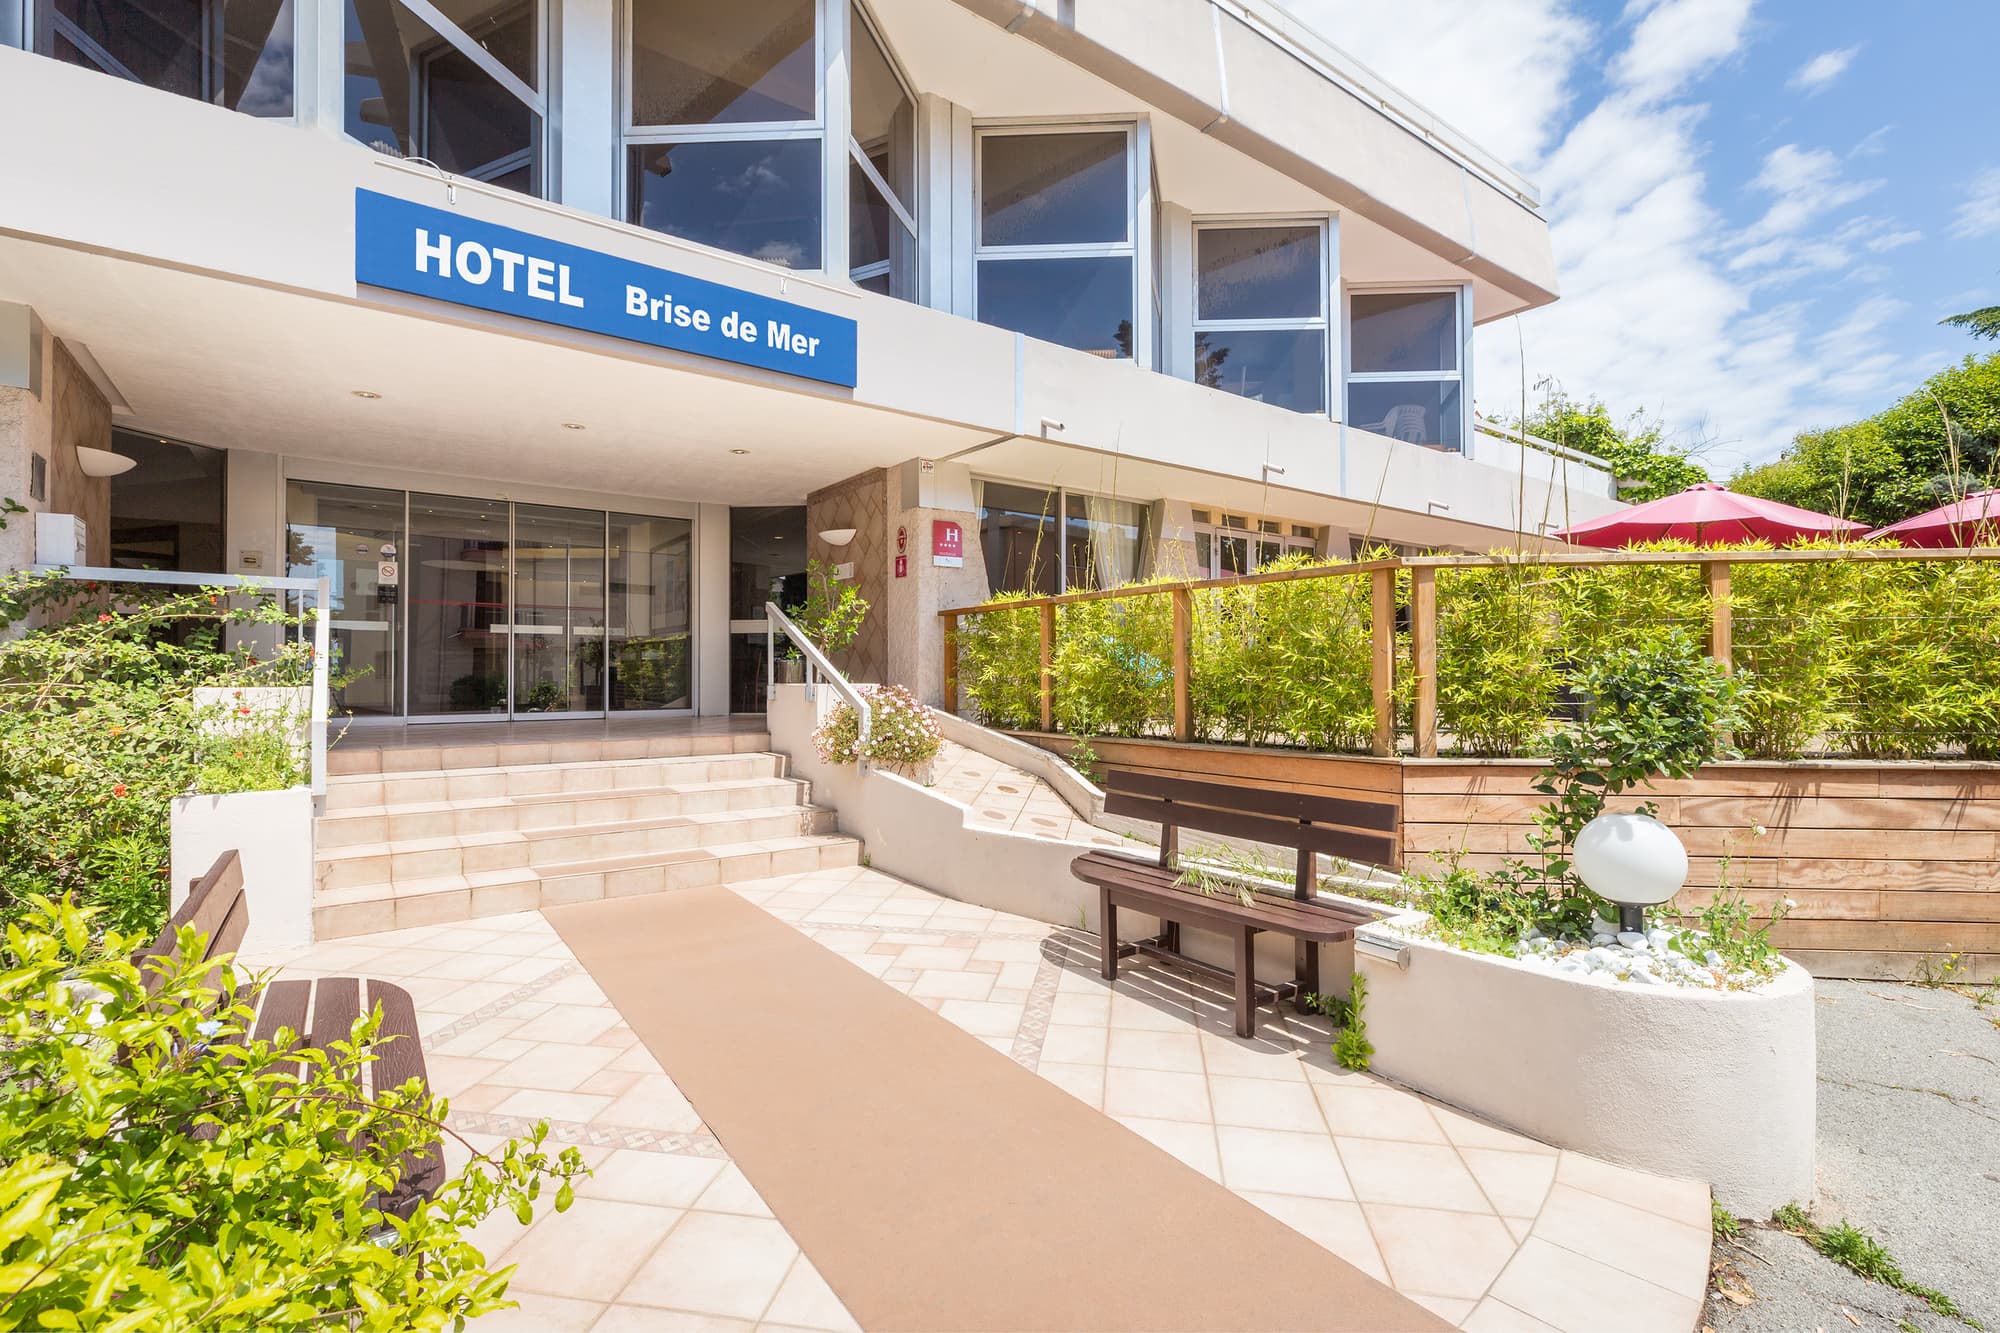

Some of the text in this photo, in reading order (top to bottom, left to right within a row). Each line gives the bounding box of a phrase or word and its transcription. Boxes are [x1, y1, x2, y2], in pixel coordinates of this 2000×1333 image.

[415, 227, 821, 357] HOTEL Brise de Mer
[946, 528, 959, 542] H
